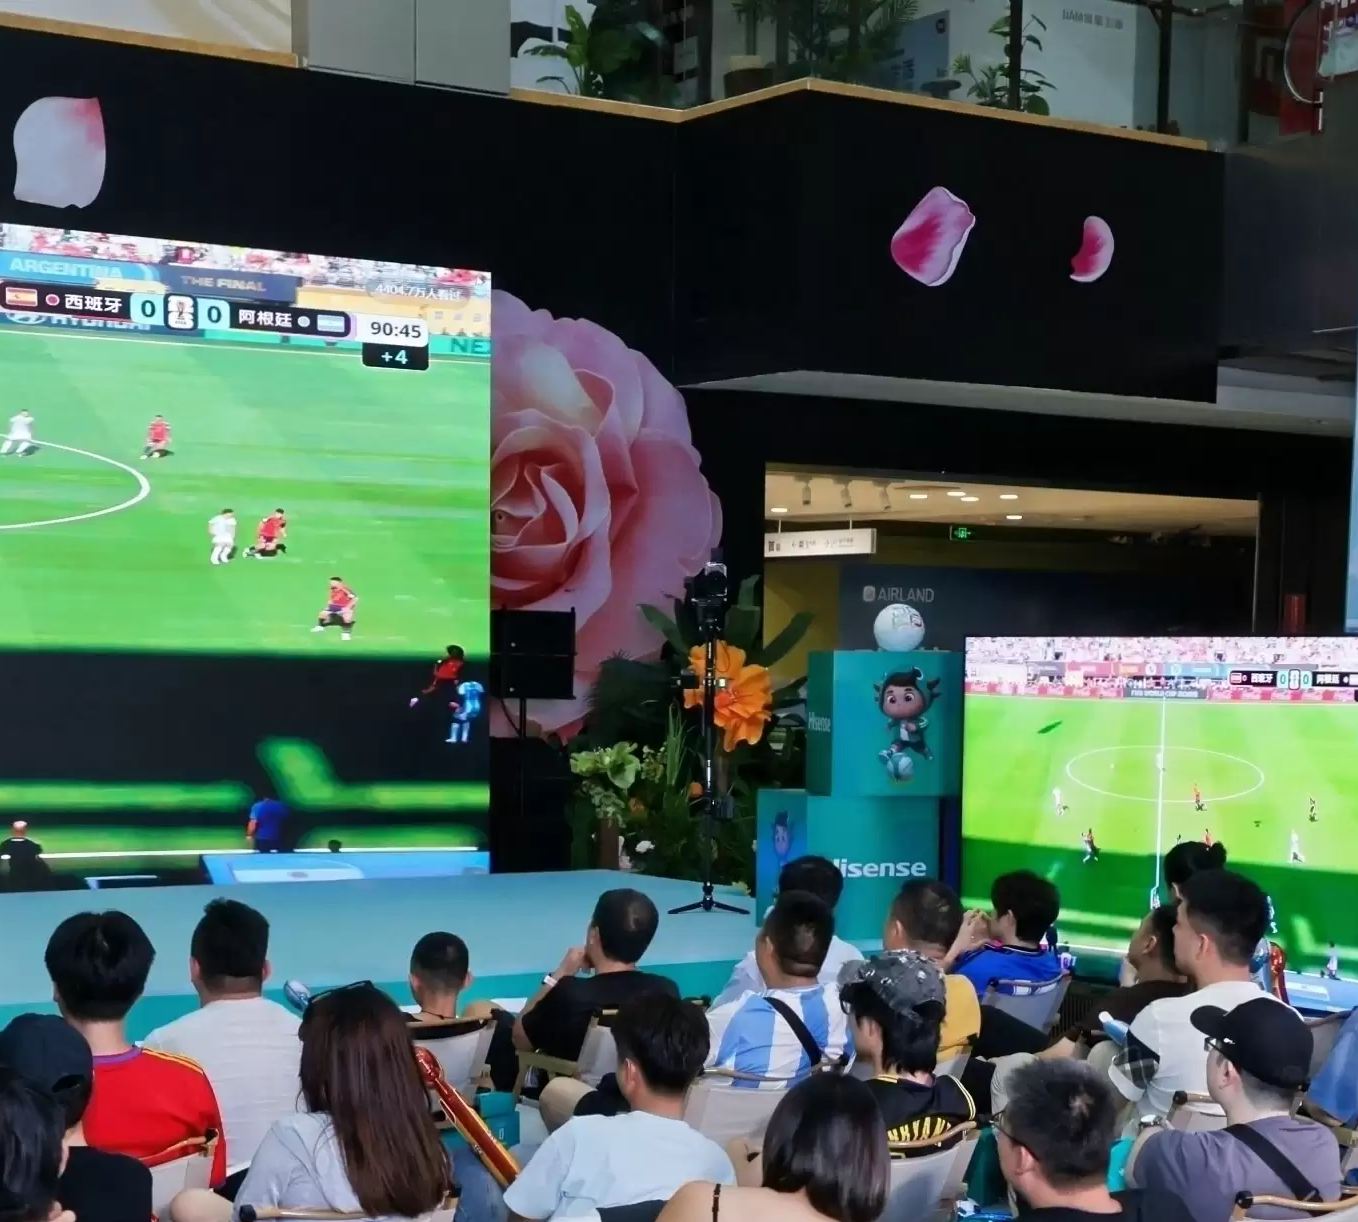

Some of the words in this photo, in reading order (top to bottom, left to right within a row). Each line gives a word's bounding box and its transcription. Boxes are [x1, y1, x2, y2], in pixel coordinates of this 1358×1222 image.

[9, 257, 124, 279] ARGENTINA
[181, 274, 216, 289] THE
[217, 277, 268, 293] FINAL
[64, 293, 123, 314] 西班牙
[141, 301, 156, 318] 0
[207, 305, 222, 324] 0
[237, 309, 293, 329] 阿根廷
[370, 321, 422, 340] 90:45
[381, 350, 409, 366] +4
[877, 587, 935, 603] AIRLAND
[808, 711, 831, 733] Hisense
